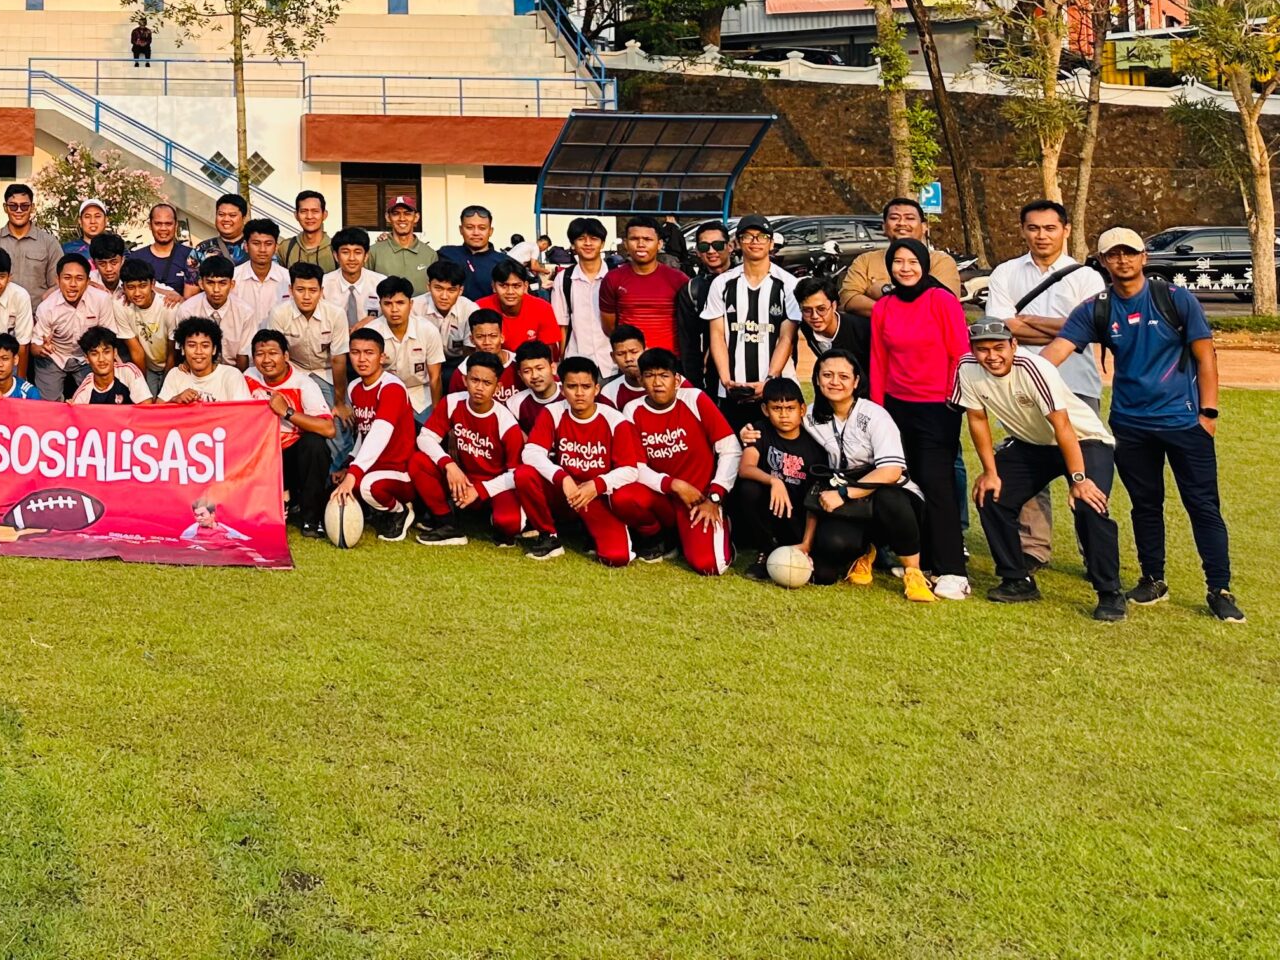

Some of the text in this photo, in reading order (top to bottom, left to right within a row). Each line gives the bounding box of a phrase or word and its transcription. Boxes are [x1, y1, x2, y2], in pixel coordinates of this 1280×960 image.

[641, 426, 687, 446] Sekolah
[558, 438, 607, 460] Sekolah
[646, 440, 688, 459] Rakyat
[560, 453, 605, 472] Rakyat
